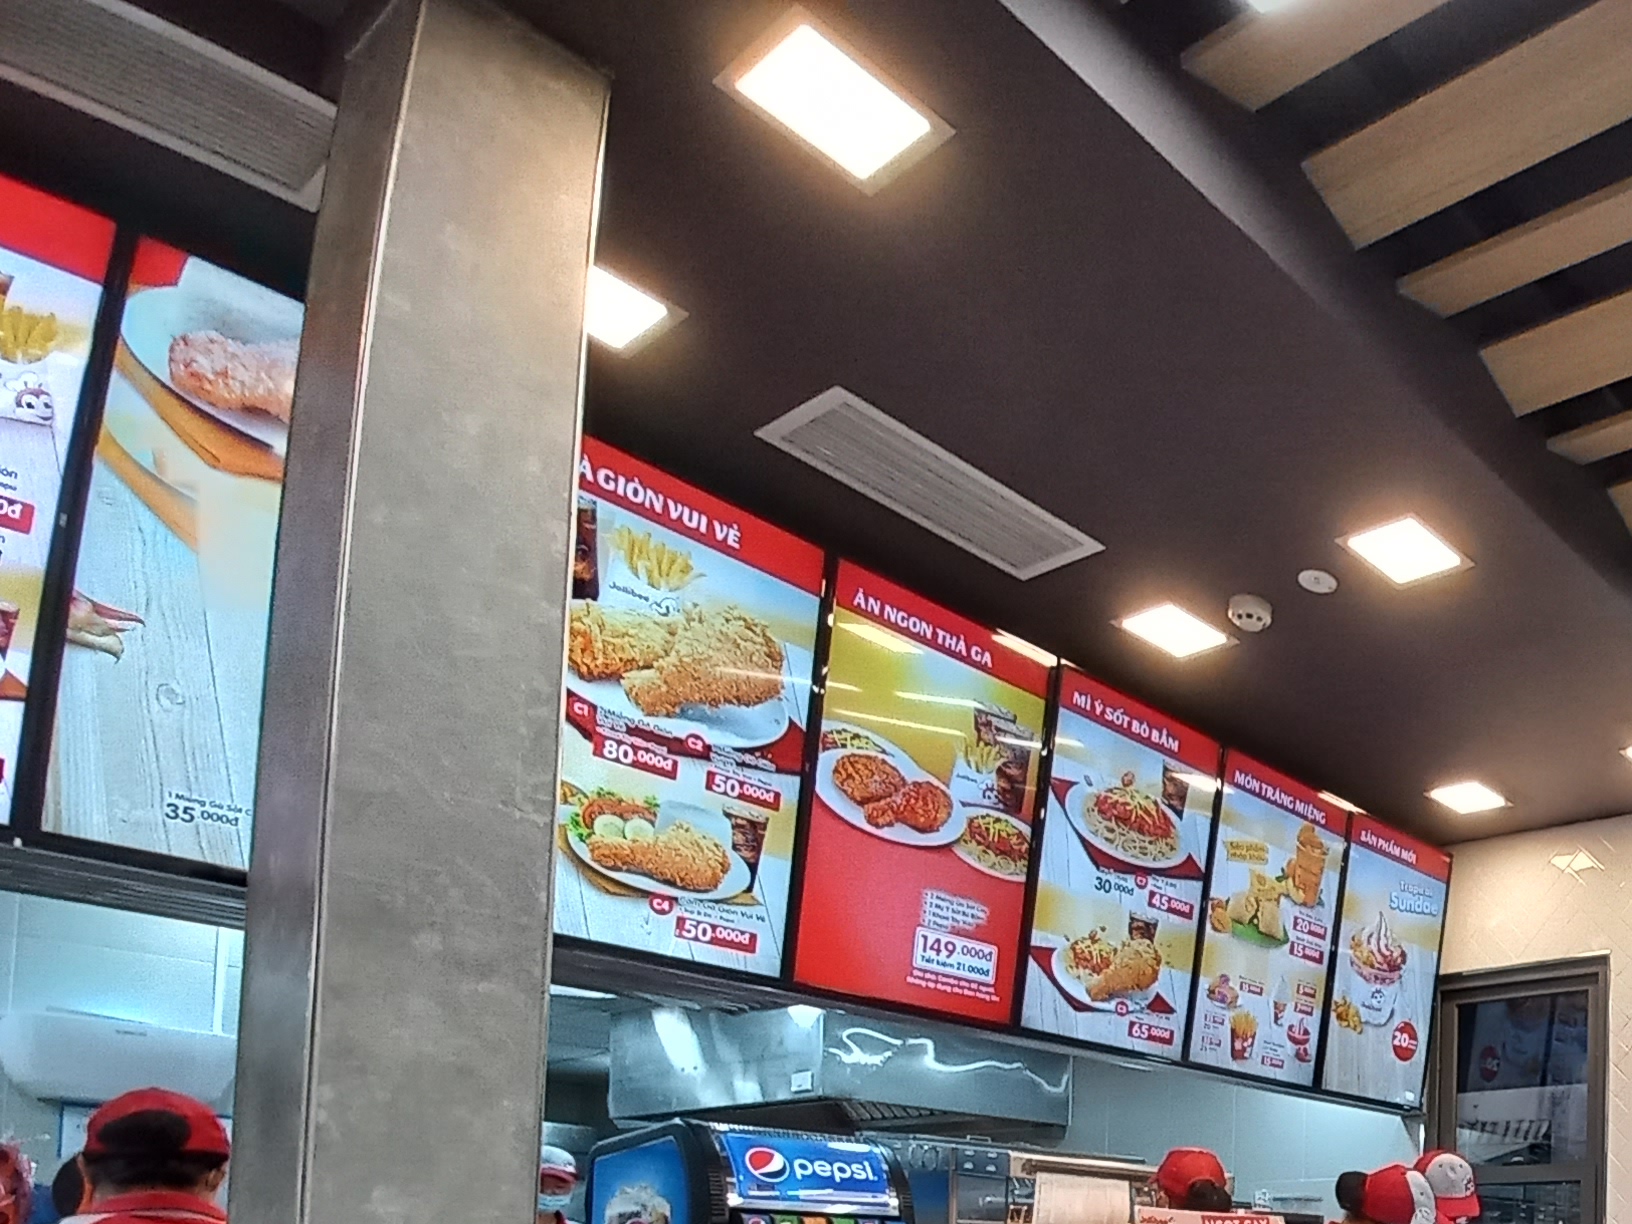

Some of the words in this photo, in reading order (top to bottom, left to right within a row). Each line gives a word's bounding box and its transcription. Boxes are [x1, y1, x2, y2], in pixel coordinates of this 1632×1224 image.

[578, 453, 594, 482] À
[597, 467, 663, 515] GIÒN
[667, 498, 708, 533] VUI
[713, 519, 741, 549] VẺ
[853, 587, 881, 616] ĂN
[884, 605, 933, 639] NGON
[935, 627, 967, 657] THẢ
[970, 645, 993, 668] GA
[573, 701, 589, 718] C1
[1104, 707, 1131, 729] SỐT
[1131, 721, 1149, 738] BÒ
[602, 739, 673, 771] 80.000đ
[712, 774, 775, 803] 50.000đ
[1234, 770, 1260, 794] MÓN
[1261, 785, 1294, 810] TRÁNG
[1295, 799, 1326, 824] MIỆNG
[165, 802, 239, 827] 35.000đ
[652, 898, 670, 912] C4
[1390, 892, 1438, 916] Sundae
[681, 919, 751, 944] 50.000đ
[921, 934, 993, 962] 149.000đ
[793, 1158, 874, 1183] pepsi
